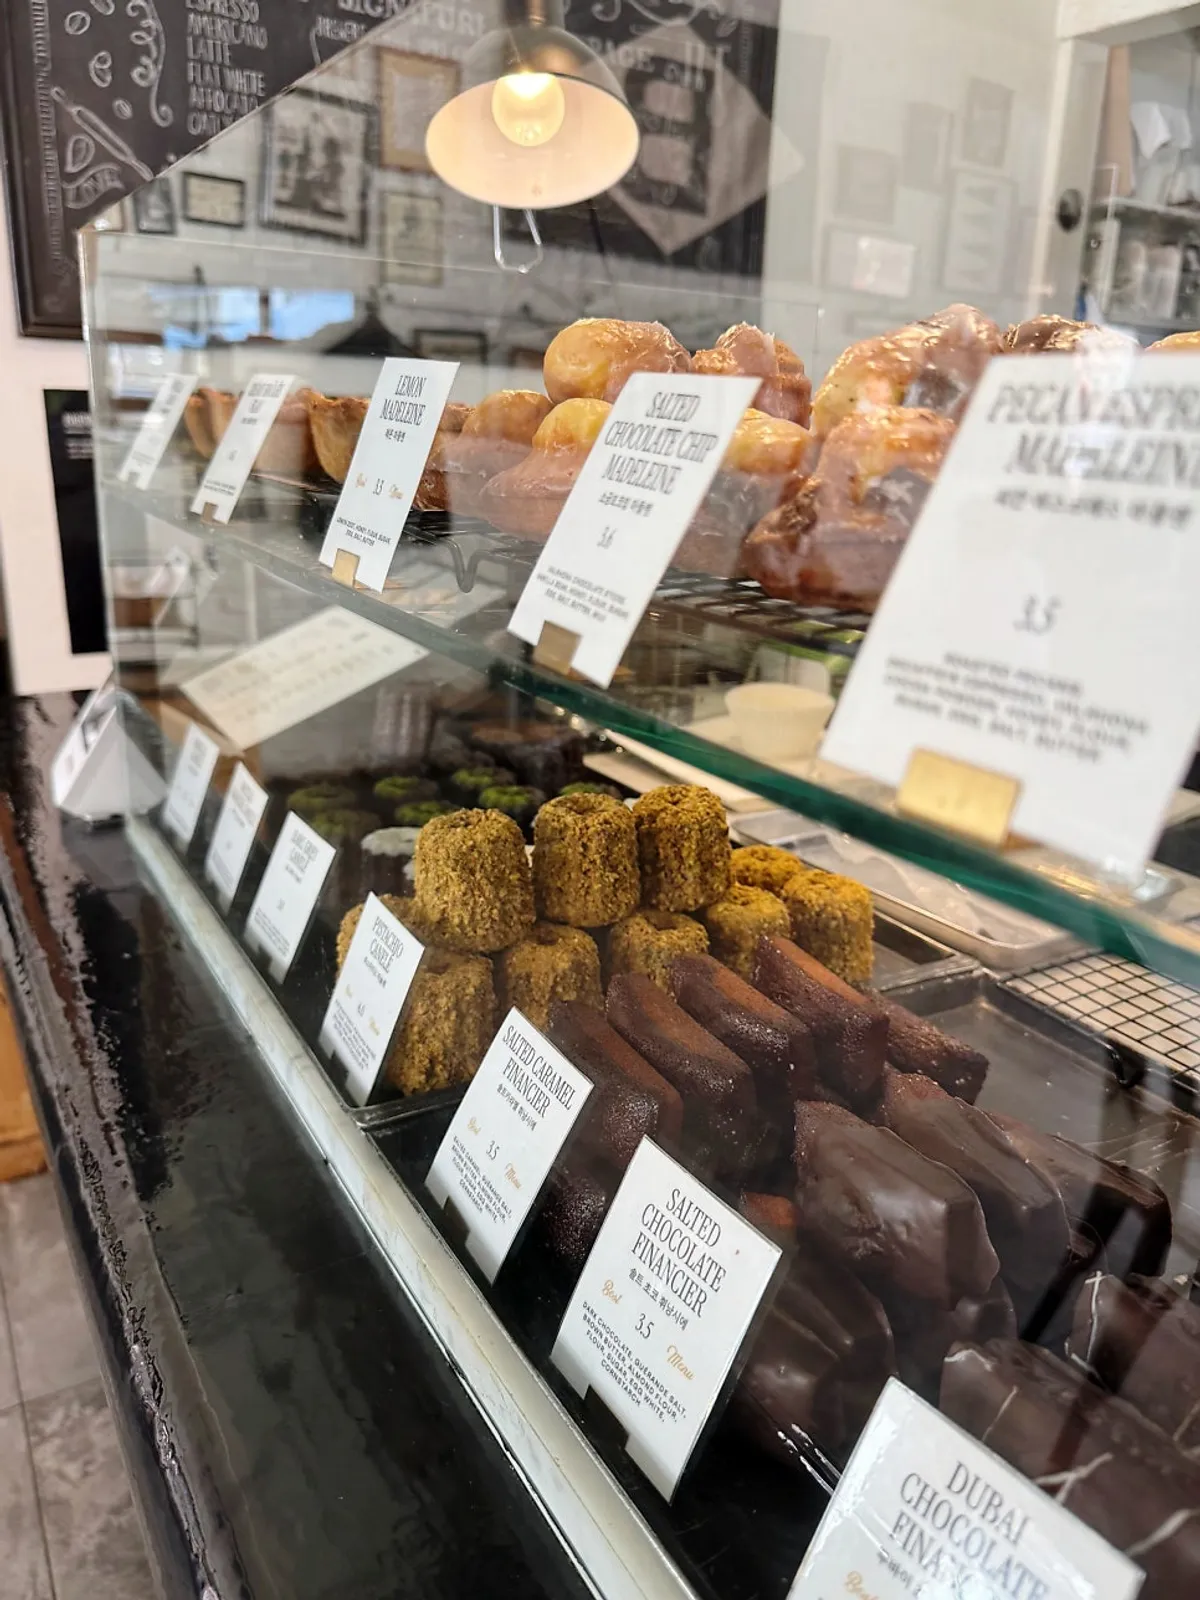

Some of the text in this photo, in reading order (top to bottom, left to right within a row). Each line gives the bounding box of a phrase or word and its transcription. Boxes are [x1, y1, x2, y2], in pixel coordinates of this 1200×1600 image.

[395, 374, 427, 398] LEMON
[645, 391, 701, 422] SALTED
[380, 398, 426, 426] MADELEINE
[604, 420, 719, 463] CHOCOLATE CHIP
[601, 454, 682, 495] MADELEINE
[373, 917, 405, 959] PISTACHIO
[503, 1025, 576, 1110] SALTED CARAMEL
[503, 1057, 550, 1118] FINANCIER
[486, 1140, 500, 1160] 3.5
[666, 1189, 721, 1247] SALTED
[642, 1204, 726, 1292] CHOCOLATE
[632, 1232, 707, 1318] FINANCIER
[583, 1302, 596, 1319] DARK
[598, 1318, 632, 1361] CHOCOLATE,
[602, 1280, 693, 1380] Best 3.5 Menu
[659, 1296, 688, 1330] 휘낭시에
[583, 1314, 603, 1339] BROWN
[628, 1364, 654, 1394] ALMOND
[602, 1359, 640, 1406] CORNSTARCH
[629, 1378, 643, 1396] EGG
[946, 1461, 1030, 1547] DUBAI
